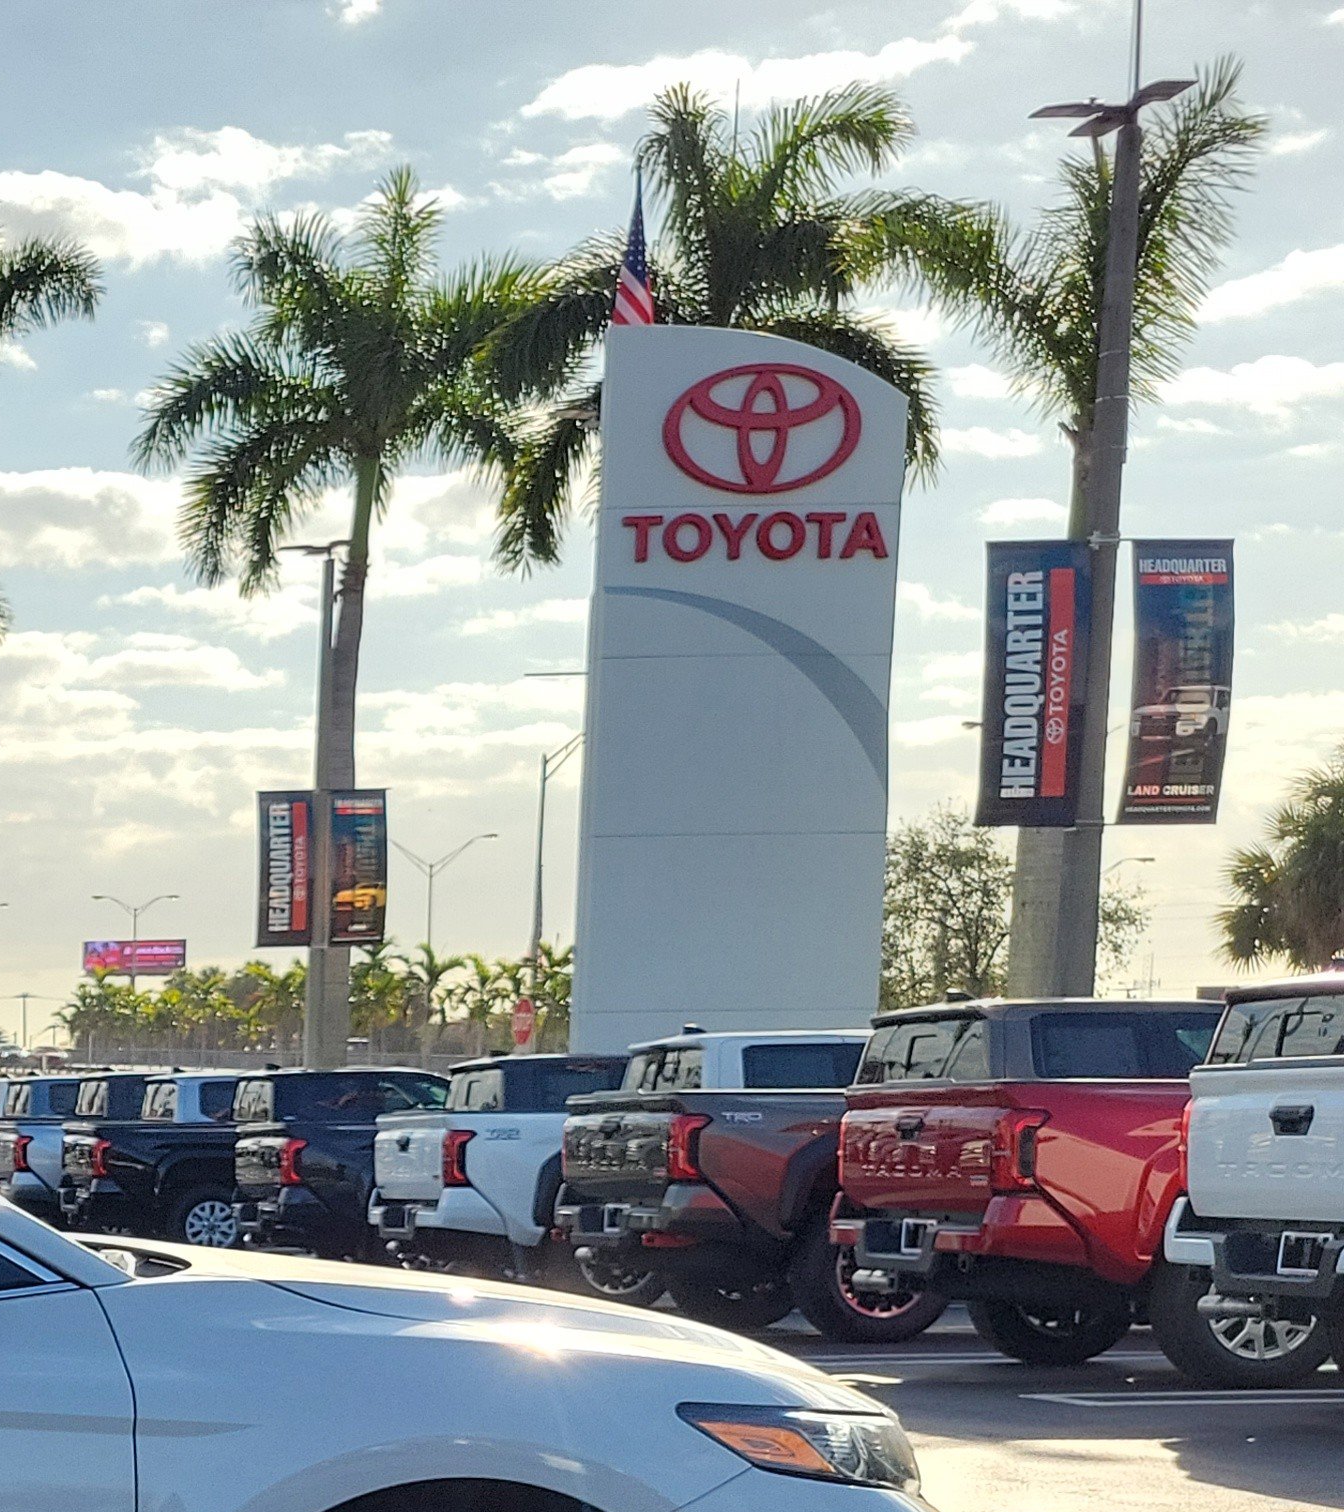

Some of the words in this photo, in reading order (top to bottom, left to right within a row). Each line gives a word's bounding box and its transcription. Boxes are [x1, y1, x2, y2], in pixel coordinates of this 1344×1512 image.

[621, 511, 889, 563] TOYOTA
[1139, 558, 1227, 574] HEADQUARTER
[999, 570, 1045, 798] HEADQUARTER
[1049, 629, 1068, 714] TOYOTA
[1127, 785, 1160, 796] LAND
[1162, 785, 1215, 796] CRUISER
[268, 803, 292, 932] HEADQUARTER
[721, 1111, 762, 1124] TRD
[861, 1164, 962, 1178] TACOMA
